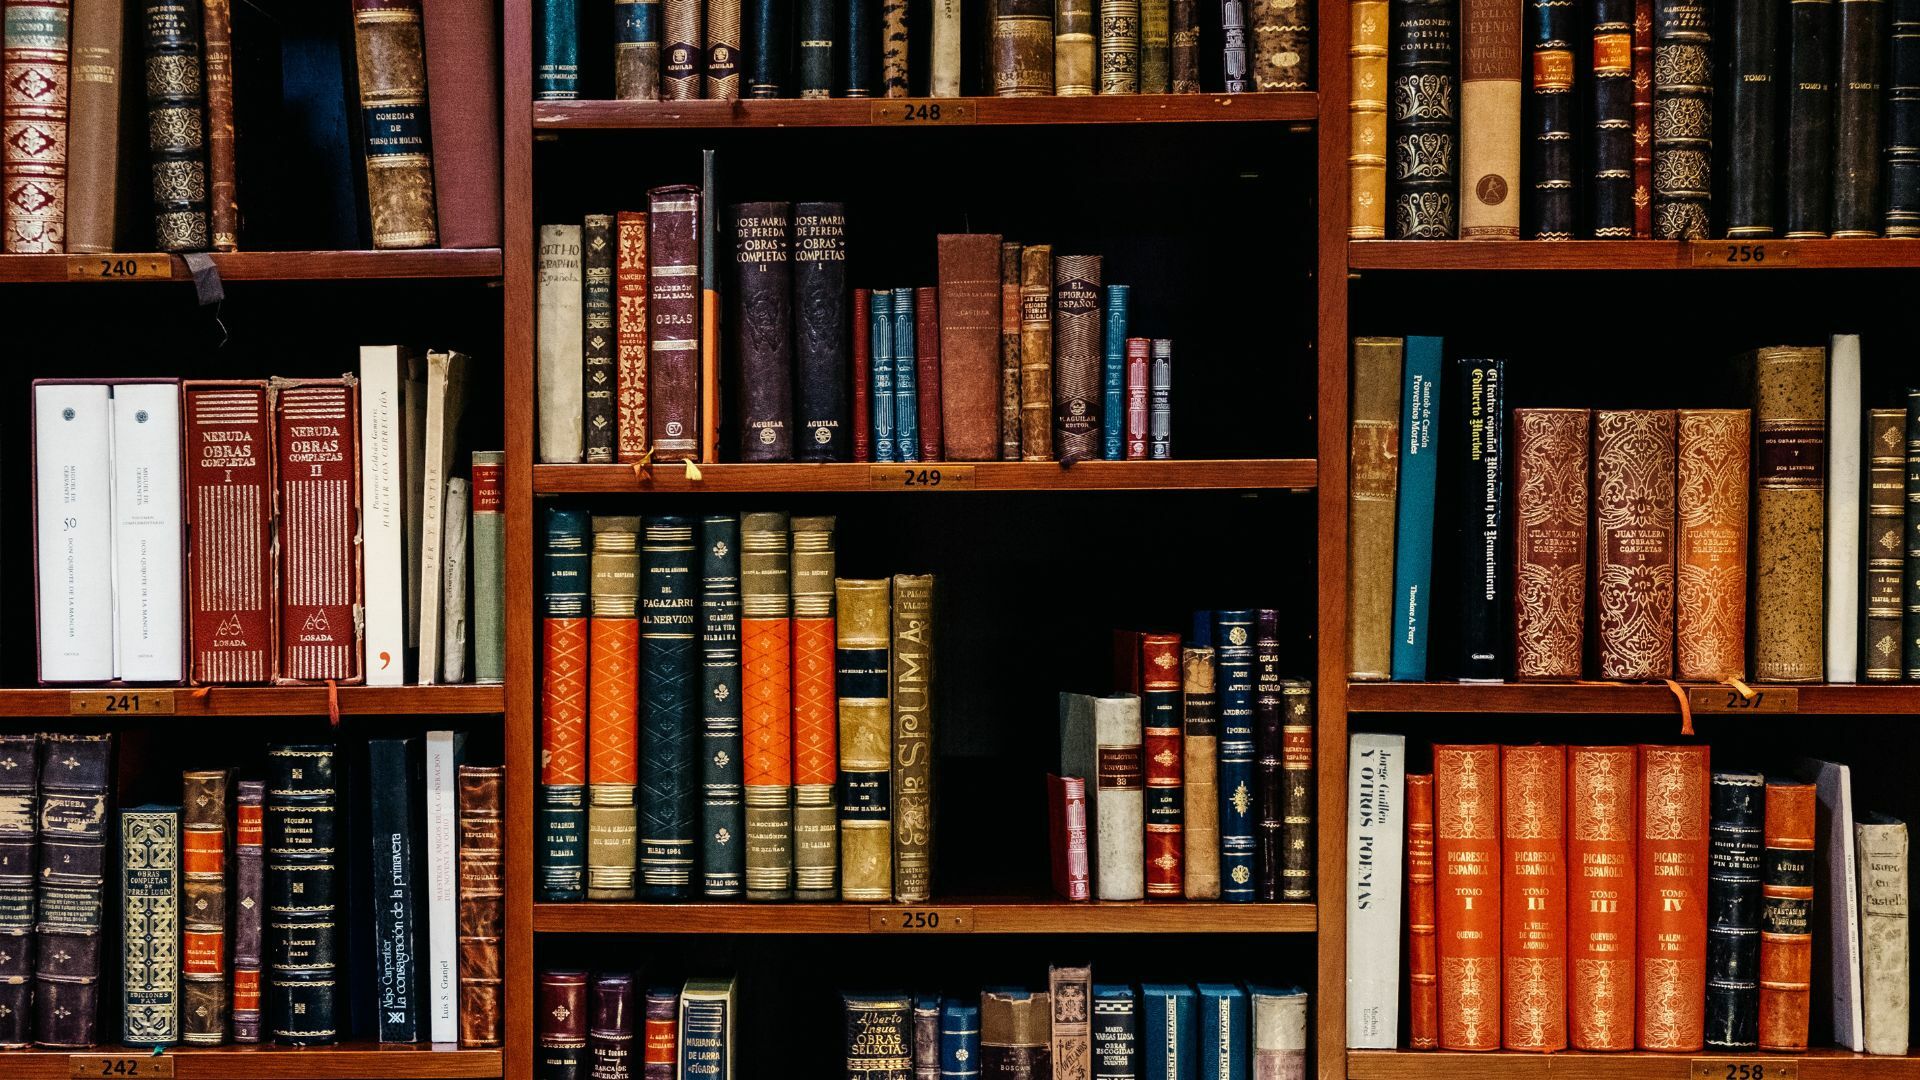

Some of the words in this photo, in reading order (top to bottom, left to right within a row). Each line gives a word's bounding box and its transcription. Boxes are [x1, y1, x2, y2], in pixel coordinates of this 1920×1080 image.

[1400, 19, 1430, 27] AMADO
[376, 112, 415, 121] COMEDIAS
[904, 104, 941, 120] 248
[390, 124, 401, 133] DE
[736, 218, 758, 227] JOSE
[761, 217, 787, 226] MARIA
[795, 216, 817, 226] JOSE
[819, 216, 845, 225] MARIA
[738, 228, 748, 238] DE
[751, 227, 784, 237] PEREDA
[797, 227, 807, 236] DE
[810, 227, 843, 236] PEREDA
[745, 240, 778, 251] OBRAS
[803, 238, 836, 249] OBRAS
[736, 251, 787, 262] COMPLETAS
[795, 250, 845, 261] COMPLETAS
[1727, 246, 1764, 262] 256
[101, 261, 137, 277] 240
[759, 264, 767, 272] II
[1071, 282, 1084, 290] EL
[1058, 291, 1097, 299] EPIGRAMA
[1058, 299, 1097, 308] ESPAÑOL
[656, 314, 693, 324] OBRAS
[1487, 368, 1497, 381] El
[1411, 375, 1422, 420] Proverbios
[1422, 381, 1432, 408] Santob
[1472, 368, 1483, 416] Edilberto
[1487, 383, 1497, 413] teatro
[1422, 409, 1430, 419] de
[378, 390, 389, 458] CORRECCIÓN
[751, 420, 784, 428] AGUILAR
[807, 420, 839, 428] AGUILAR
[202, 431, 252, 442] NERUDA
[290, 426, 340, 437] NERUDA
[1410, 420, 1420, 455] Morales
[1421, 419, 1430, 448] Carrión
[1485, 415, 1497, 453] español
[203, 445, 251, 458] OBRAS
[291, 440, 339, 452] OBRAS
[201, 457, 256, 468] COMPLETAS
[289, 453, 343, 462] COMPLETAS
[225, 470, 232, 482] I
[310, 464, 323, 476] II
[381, 460, 389, 481] CON
[904, 470, 941, 486] 249
[1484, 456, 1497, 502] Medieval
[1487, 514, 1496, 527] del
[1529, 530, 1550, 538] JUAN
[1552, 530, 1580, 538] VALERA
[1614, 530, 1637, 538] JUAN
[1484, 530, 1496, 600] Renacimiento
[643, 599, 693, 607] PAGAZARRI
[1409, 585, 1418, 616] Theodore
[643, 616, 652, 624] AL
[653, 616, 693, 624] NERVION
[1409, 617, 1416, 625] A.
[300, 634, 333, 642] LOSADA
[1407, 626, 1416, 645] Perry
[106, 695, 139, 711] 241
[1360, 749, 1374, 762] Y
[1378, 750, 1391, 781] Jorge
[1359, 767, 1374, 827] OTROS
[1378, 784, 1390, 825] Guillén
[63, 854, 70, 863] 2
[390, 833, 406, 886] primavera
[1448, 852, 1489, 862] PICARESCA
[1515, 852, 1556, 862] PICARESCA
[1583, 853, 1625, 865] PICARESCA
[1654, 852, 1695, 864] PICARESCA
[1358, 836, 1373, 910] POEMAS
[1448, 864, 1488, 875] ESPAÑOLA
[1515, 864, 1555, 875] ESPAÑOLA
[1584, 866, 1624, 878] ESPAÑOLA
[1654, 865, 1693, 877] ESPAÑOLA
[391, 888, 403, 898] la
[1455, 888, 1483, 896] TOMO
[1522, 888, 1550, 896] TOMO
[1590, 891, 1618, 899] TOMO
[1660, 889, 1688, 898] TOMO
[1465, 898, 1473, 910] I
[1528, 898, 1545, 911] II
[1590, 900, 1618, 913] III
[1663, 898, 1686, 912] IV
[392, 902, 404, 919] de
[902, 912, 939, 928] 250
[1456, 931, 1483, 939] QUEVEDO
[382, 939, 393, 985] Carpentier
[392, 921, 410, 994] consagración
[439, 960, 450, 989] Granjel
[383, 987, 394, 1009] Alejo
[394, 996, 407, 1009] La
[440, 993, 449, 1001] S.
[441, 1003, 450, 1020] Luis
[857, 1012, 902, 1024] Alberto
[241, 1028, 247, 1036] 3
[862, 1024, 896, 1034] Insua
[686, 1038, 716, 1046] MARIANO
[856, 1034, 901, 1045] OBRAS
[1095, 1033, 1116, 1041] VARGAS
[852, 1044, 907, 1055] SELECTAS
[688, 1052, 699, 1060] DE
[699, 1052, 720, 1060] LARRA
[102, 1060, 138, 1075] 242
[1726, 1065, 1763, 1080] 258
